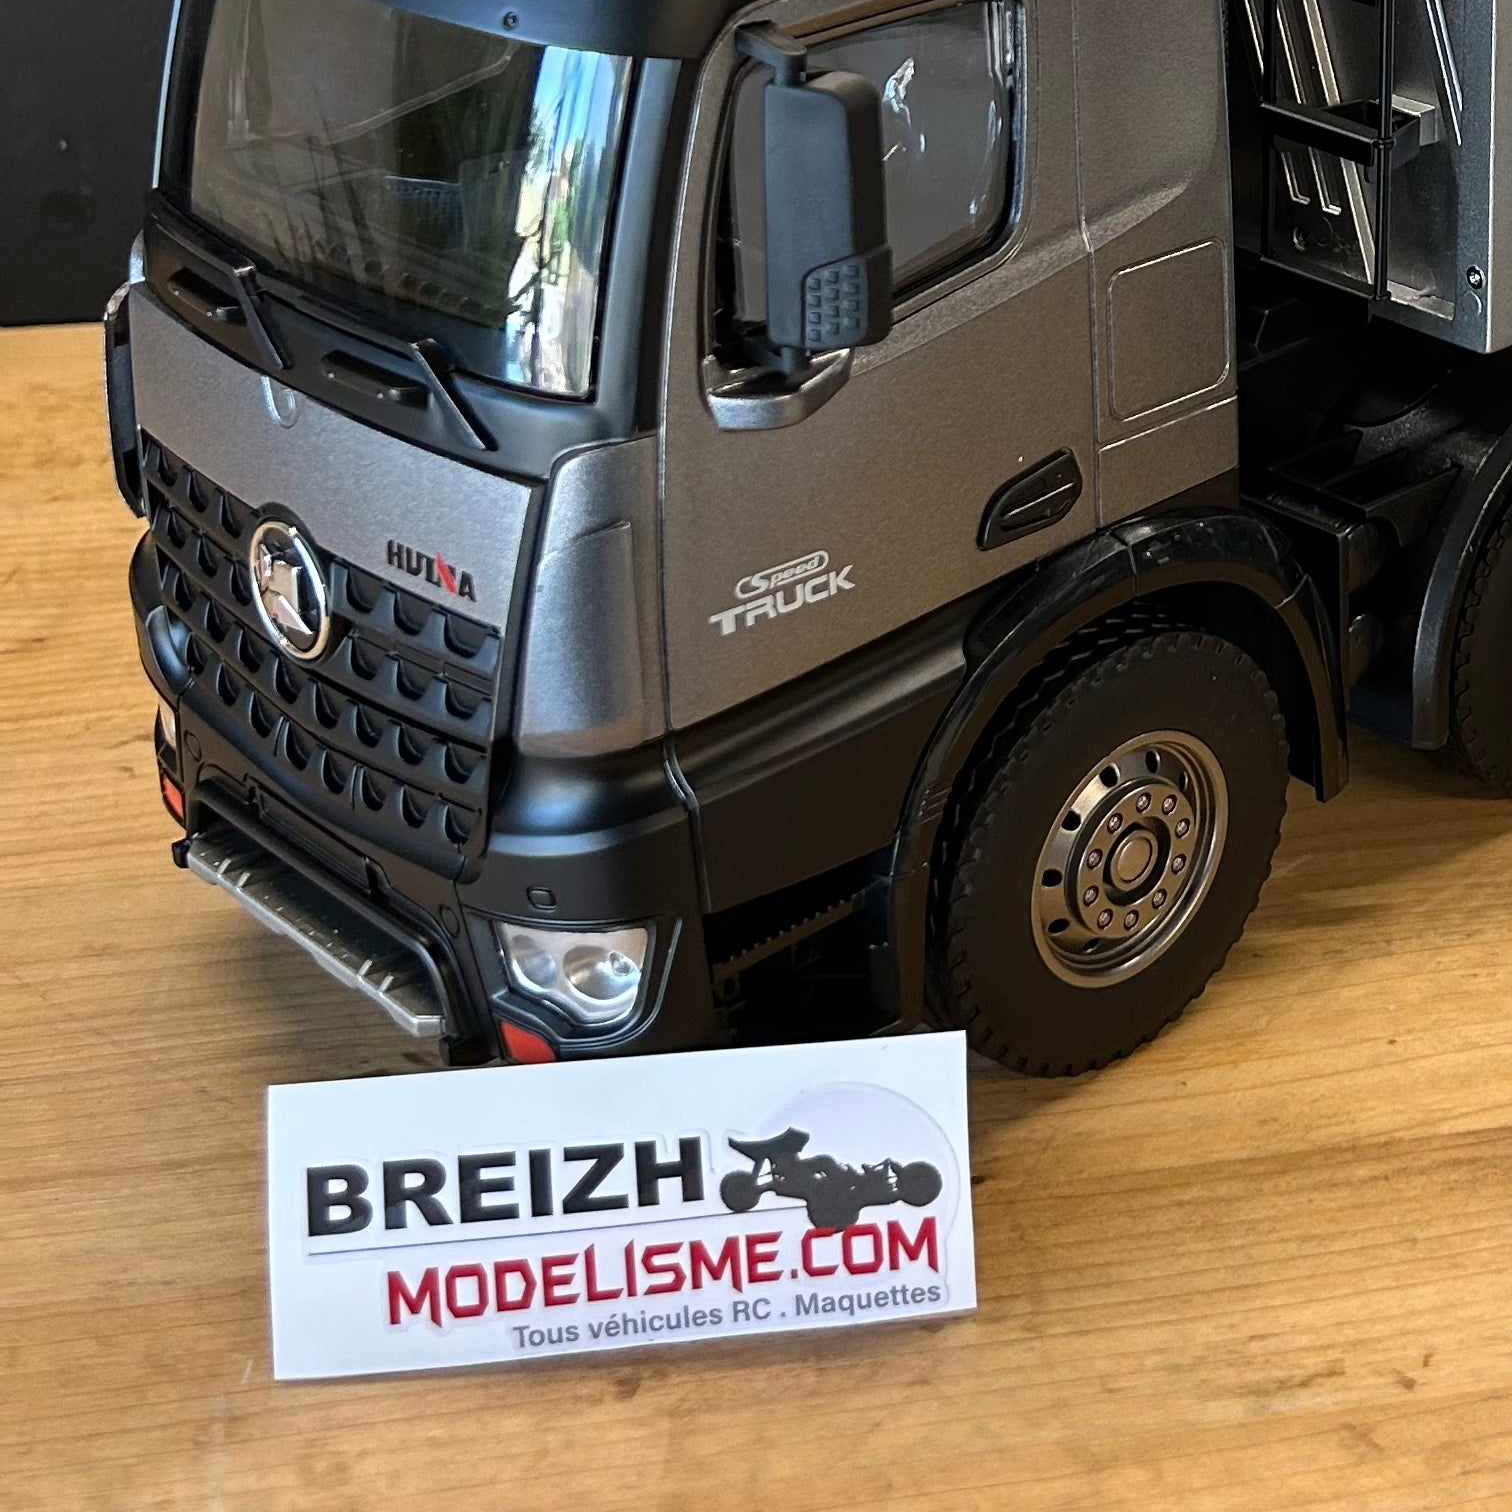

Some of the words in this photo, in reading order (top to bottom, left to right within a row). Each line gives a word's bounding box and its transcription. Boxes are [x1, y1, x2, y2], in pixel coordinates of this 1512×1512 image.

[709, 564, 856, 636] TRUCK
[750, 556, 821, 592] Speed
[307, 1136, 705, 1237] BREIZH
[386, 1216, 939, 1327] MODELISME.COM
[513, 1325, 580, 1349] Tous
[588, 1304, 723, 1340] véhicules
[795, 1284, 942, 1318] Maquettes
